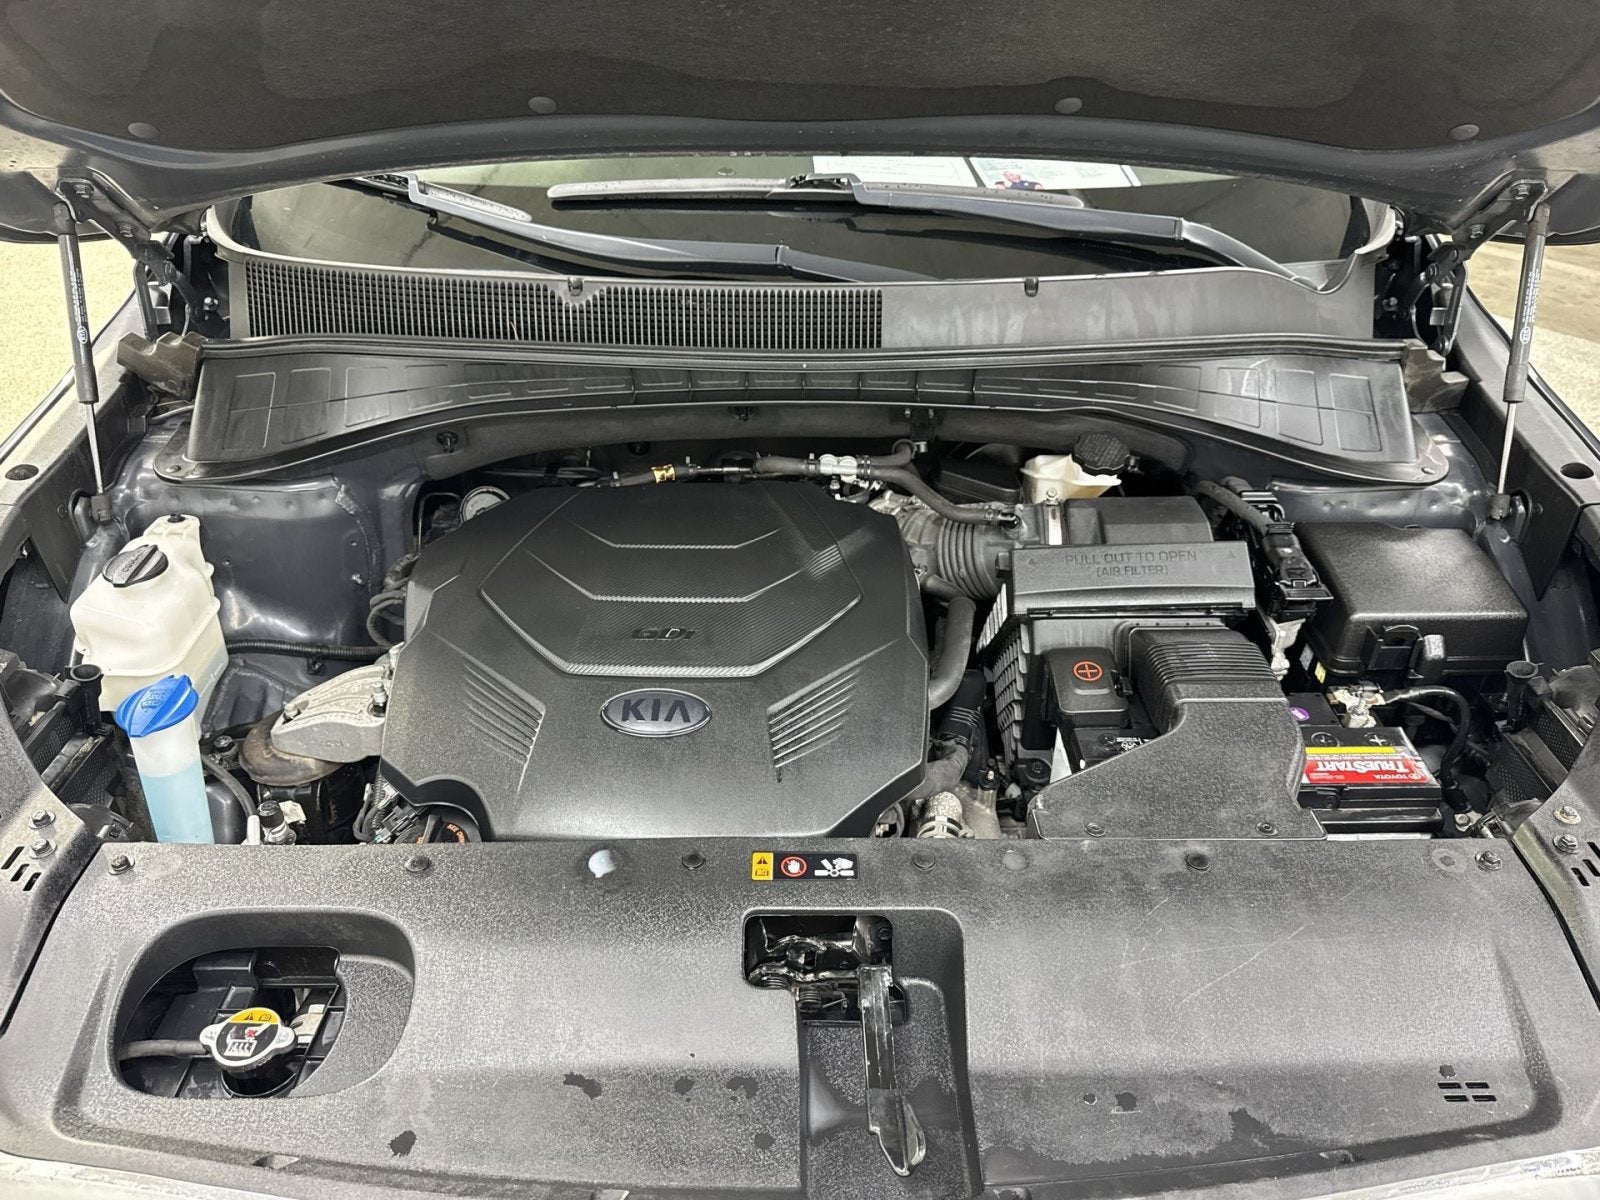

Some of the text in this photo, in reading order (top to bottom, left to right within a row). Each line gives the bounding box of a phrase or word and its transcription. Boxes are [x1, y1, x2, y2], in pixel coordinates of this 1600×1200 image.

[1064, 550, 1197, 565] PULL OUT TO OPEN
[1096, 564, 1169, 577] (AIR FILTER)
[621, 699, 691, 723] KIA
